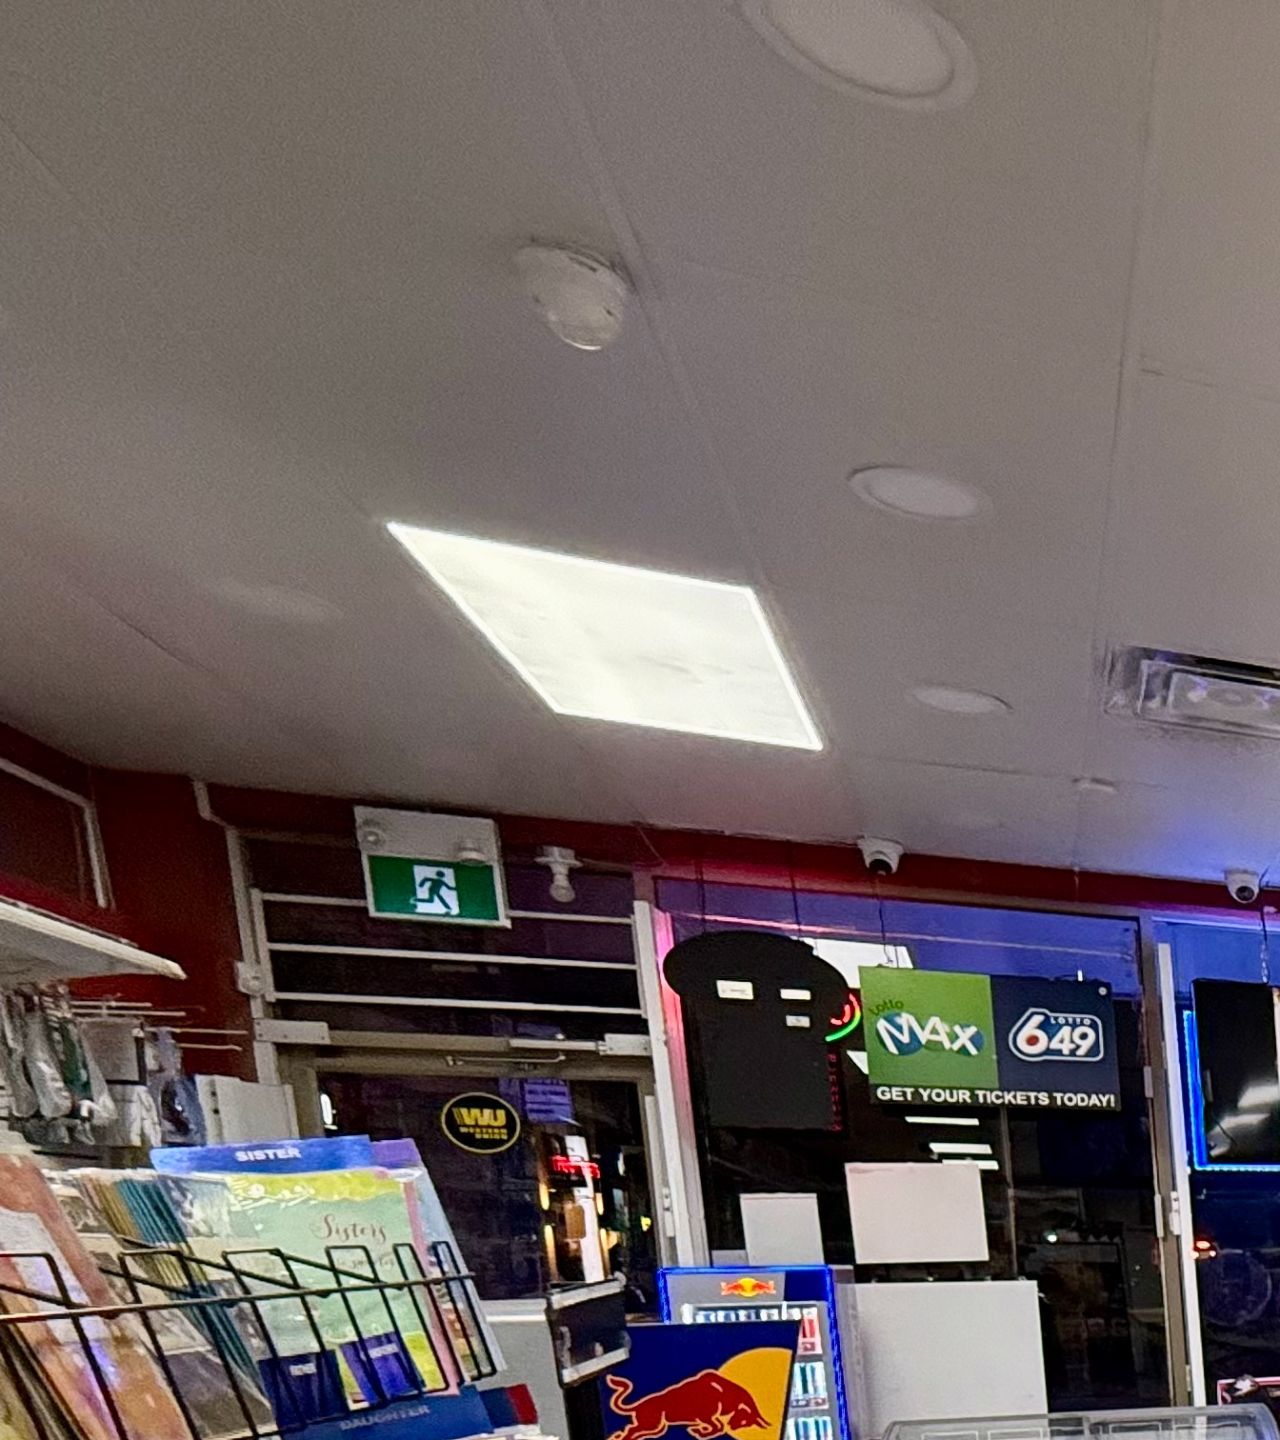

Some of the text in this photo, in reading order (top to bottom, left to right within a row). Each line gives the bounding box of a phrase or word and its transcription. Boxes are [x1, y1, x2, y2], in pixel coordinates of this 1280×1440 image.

[1051, 1017, 1091, 1026] LOTTO
[877, 1012, 979, 1056] MAX
[877, 1086, 1115, 1107] GET YOUR TICKETS TODAY!
[452, 1107, 507, 1126] WU
[235, 1147, 301, 1162] SISTER
[322, 1213, 387, 1242] Sisters
[340, 1404, 430, 1430] DAUGHTER
